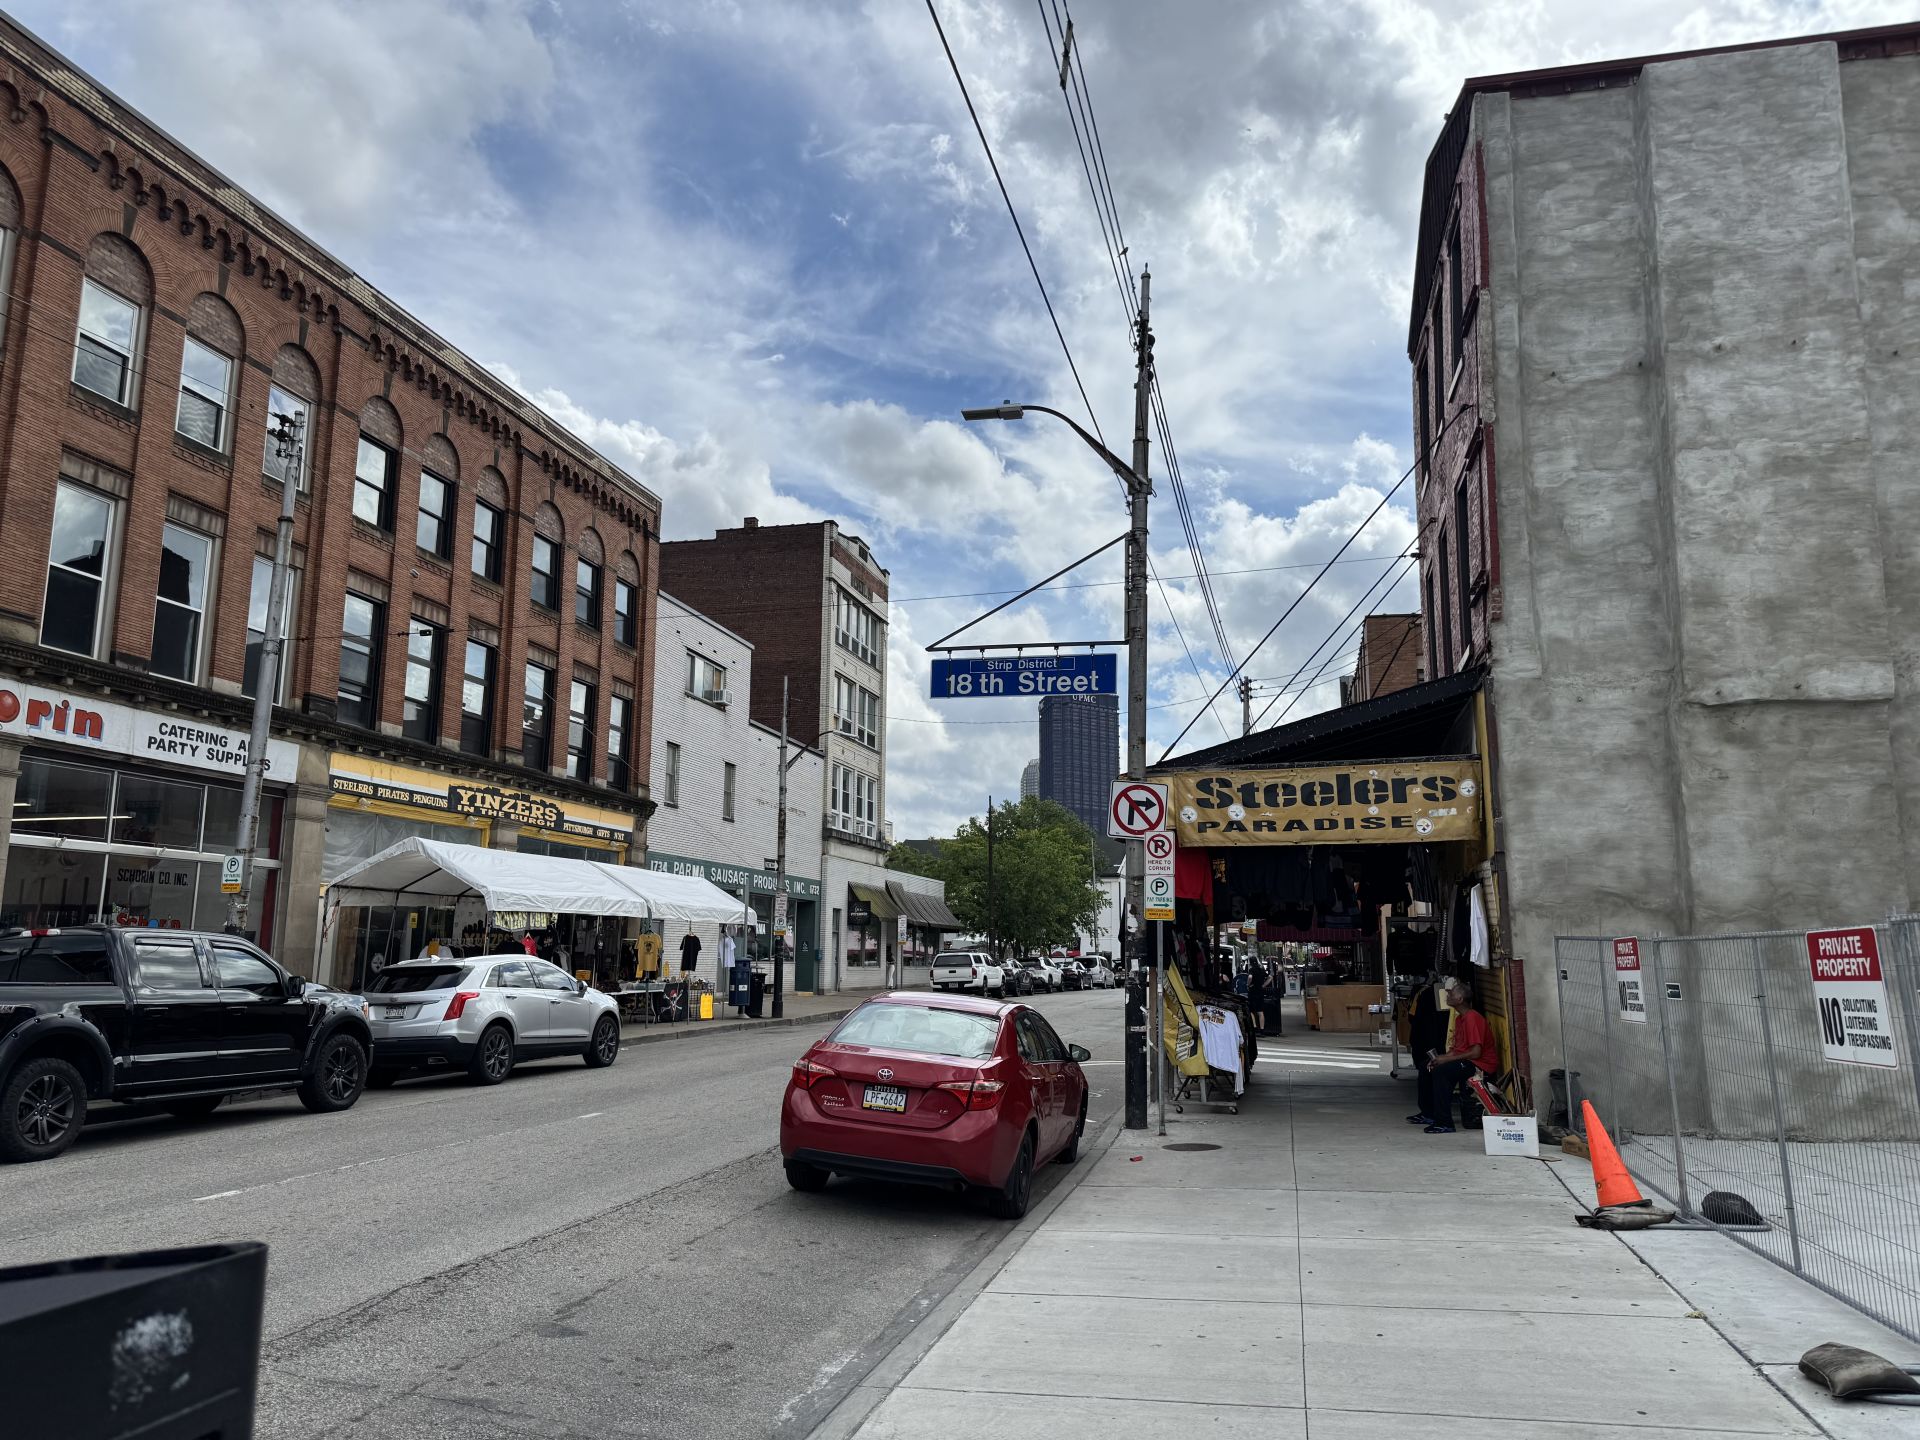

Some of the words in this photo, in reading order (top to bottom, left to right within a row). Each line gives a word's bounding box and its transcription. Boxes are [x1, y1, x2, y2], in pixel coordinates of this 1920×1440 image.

[987, 660, 1013, 672] Strip
[1018, 658, 1058, 669] District
[946, 673, 973, 695] 18
[979, 672, 1004, 694] th
[1018, 670, 1099, 693] Street
[1072, 694, 1097, 704] UPMC
[158, 722, 229, 748] CATERING
[147, 736, 200, 757] PARTY
[206, 747, 271, 771] SUPPLS
[333, 778, 374, 795] STEELERS
[377, 787, 410, 801] PIRATES
[412, 793, 449, 808] PENGUINS
[1196, 774, 1457, 809] Steelers
[456, 788, 558, 822] YINZERS
[457, 804, 474, 813] IN
[479, 808, 505, 818] THE
[510, 813, 555, 828] BURGH
[1197, 815, 1414, 834] PARADISE
[563, 822, 594, 835] PITTSBURGH
[596, 829, 611, 838] GIFTS
[117, 868, 155, 884] SCHORIN
[158, 871, 172, 885] CO.
[173, 872, 189, 887] INC.
[650, 860, 668, 873] 1734
[673, 861, 705, 879] PARMA
[710, 867, 750, 886] SAUSAGE
[809, 885, 820, 896] 1732
[1818, 935, 1863, 956] PRIVATE
[1816, 957, 1871, 977] PROPERTY
[1842, 998, 1878, 1014] SOLICITING
[1819, 997, 1845, 1047] NO
[1844, 1015, 1879, 1031] LOITERING
[1846, 1032, 1892, 1050] TRESPASSING
